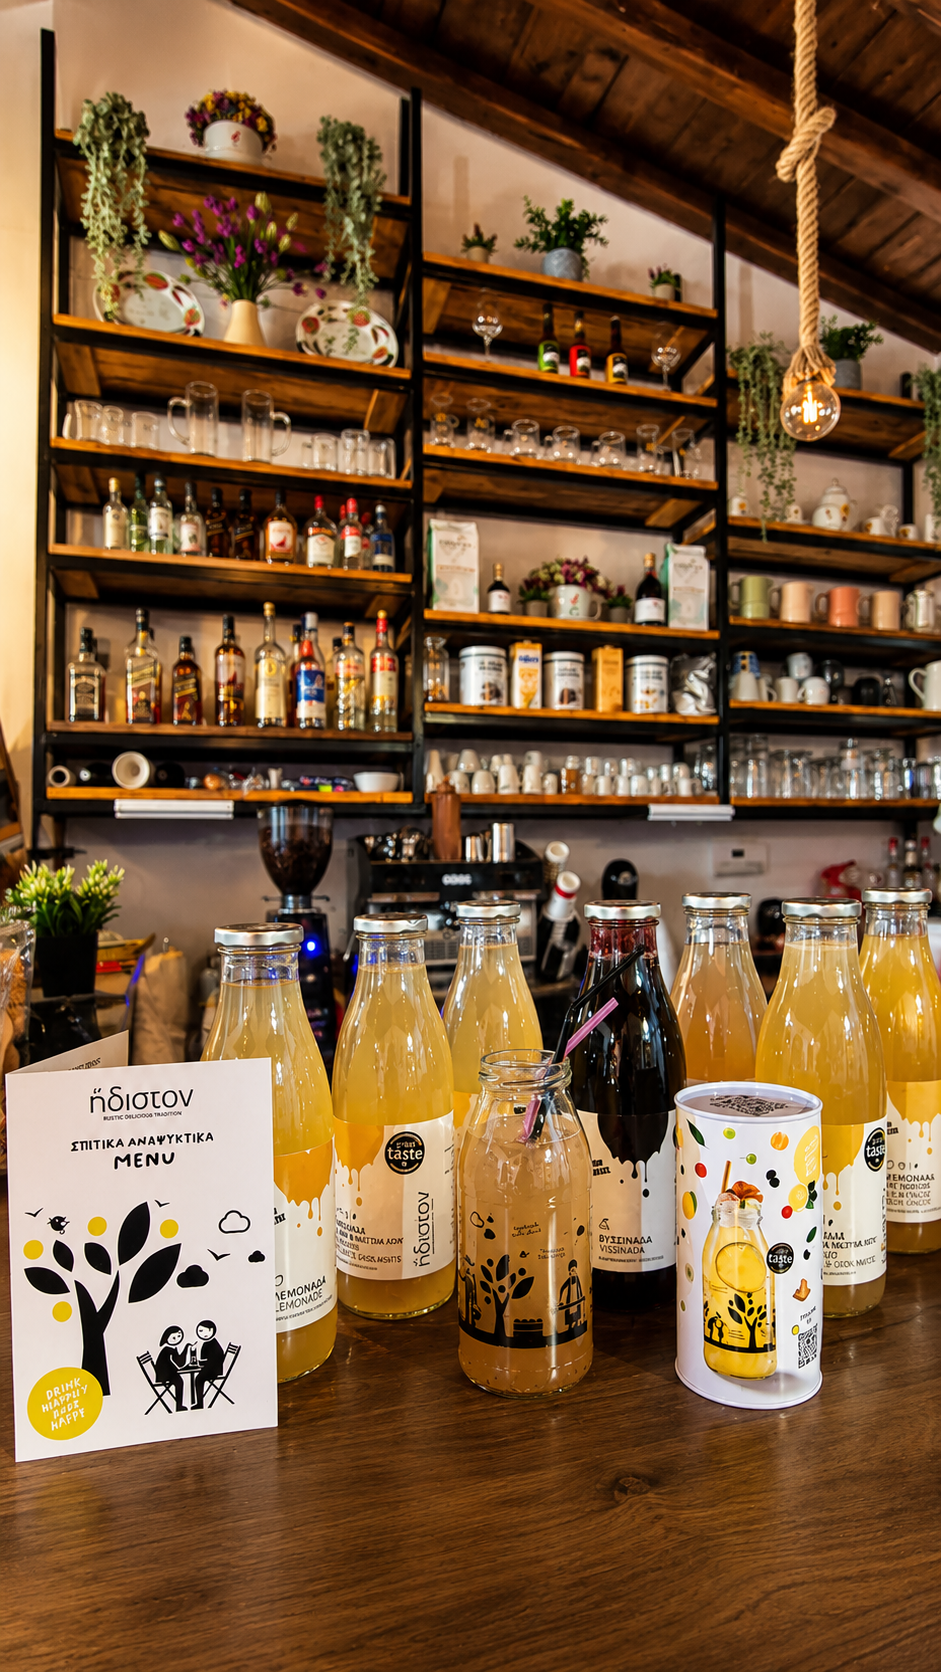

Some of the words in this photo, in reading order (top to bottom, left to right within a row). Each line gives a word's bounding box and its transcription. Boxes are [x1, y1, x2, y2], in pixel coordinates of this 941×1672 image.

[70, 1138, 125, 1152] ΣΠΙΤΙΚΑ
[128, 1132, 214, 1147] ΑΝΑΨΥΚΤΙΚΑ
[387, 1147, 423, 1160] taste
[114, 1151, 175, 1170] MENU
[599, 1244, 646, 1254] VISSINADA
[768, 1253, 793, 1264] taste
